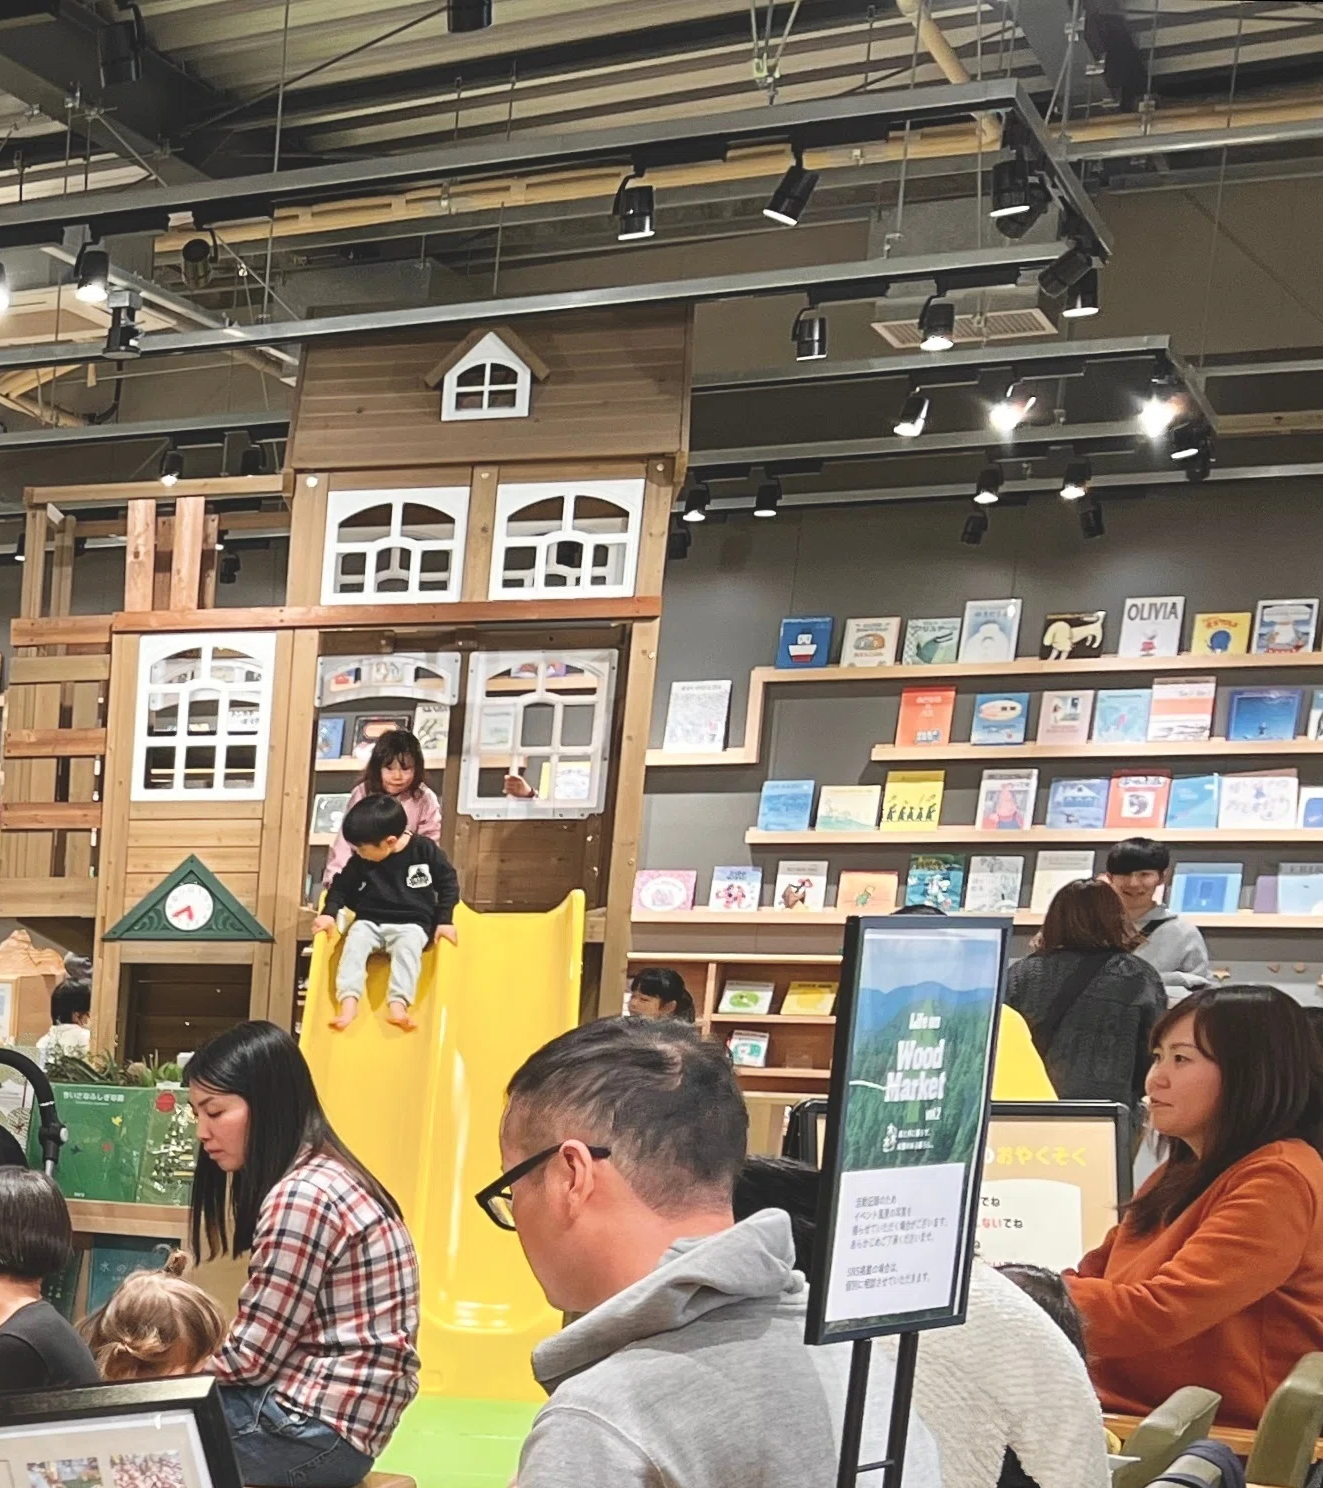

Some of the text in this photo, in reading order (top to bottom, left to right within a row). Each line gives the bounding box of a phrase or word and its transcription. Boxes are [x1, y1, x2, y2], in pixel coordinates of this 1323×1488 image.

[1127, 601, 1179, 621] OLIVIA
[896, 1038, 946, 1071] Wood
[884, 1071, 947, 1102] Market
